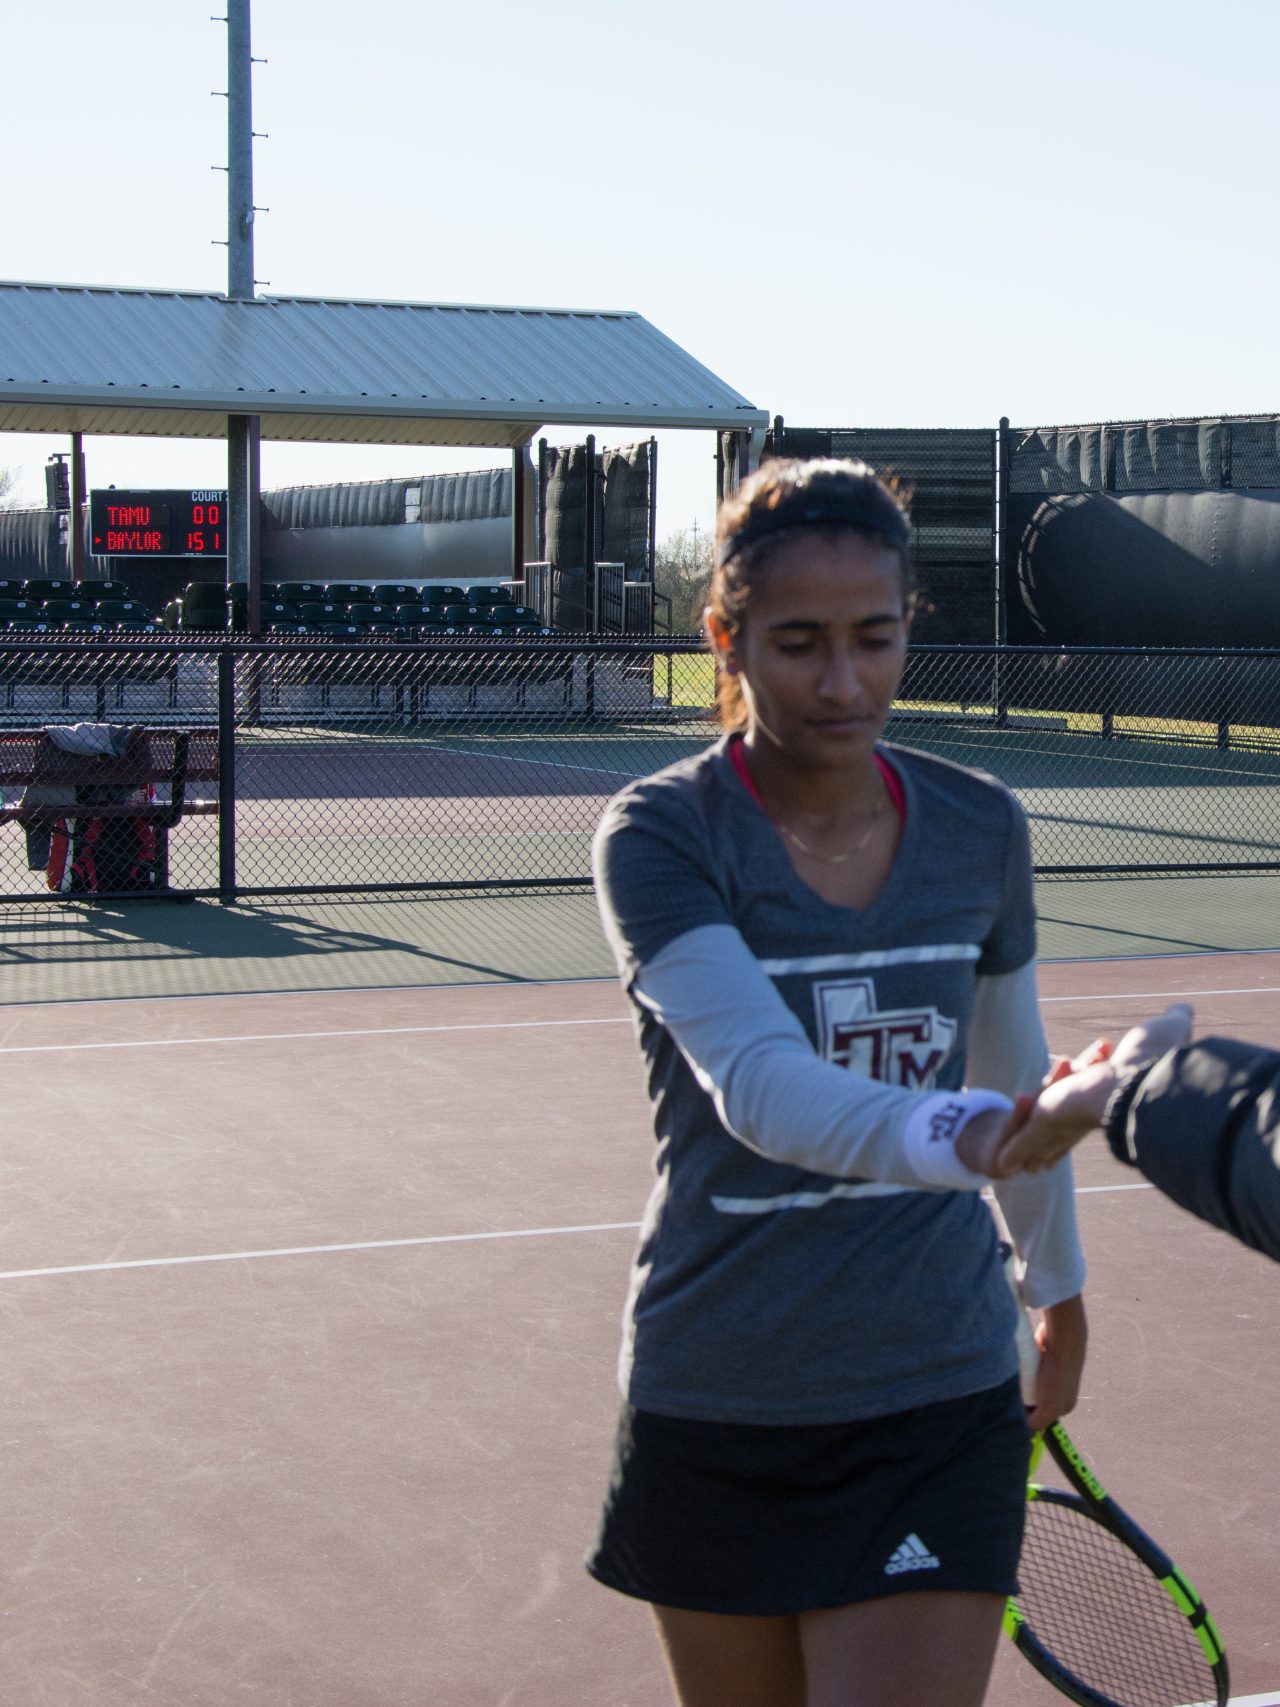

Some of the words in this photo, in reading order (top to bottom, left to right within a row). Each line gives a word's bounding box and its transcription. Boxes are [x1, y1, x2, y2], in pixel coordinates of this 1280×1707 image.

[191, 491, 223, 502] COURT
[107, 506, 151, 526] TAMU
[107, 531, 161, 551] BAYLOR
[187, 531, 205, 551] 15
[884, 1555, 941, 1576] adidas
